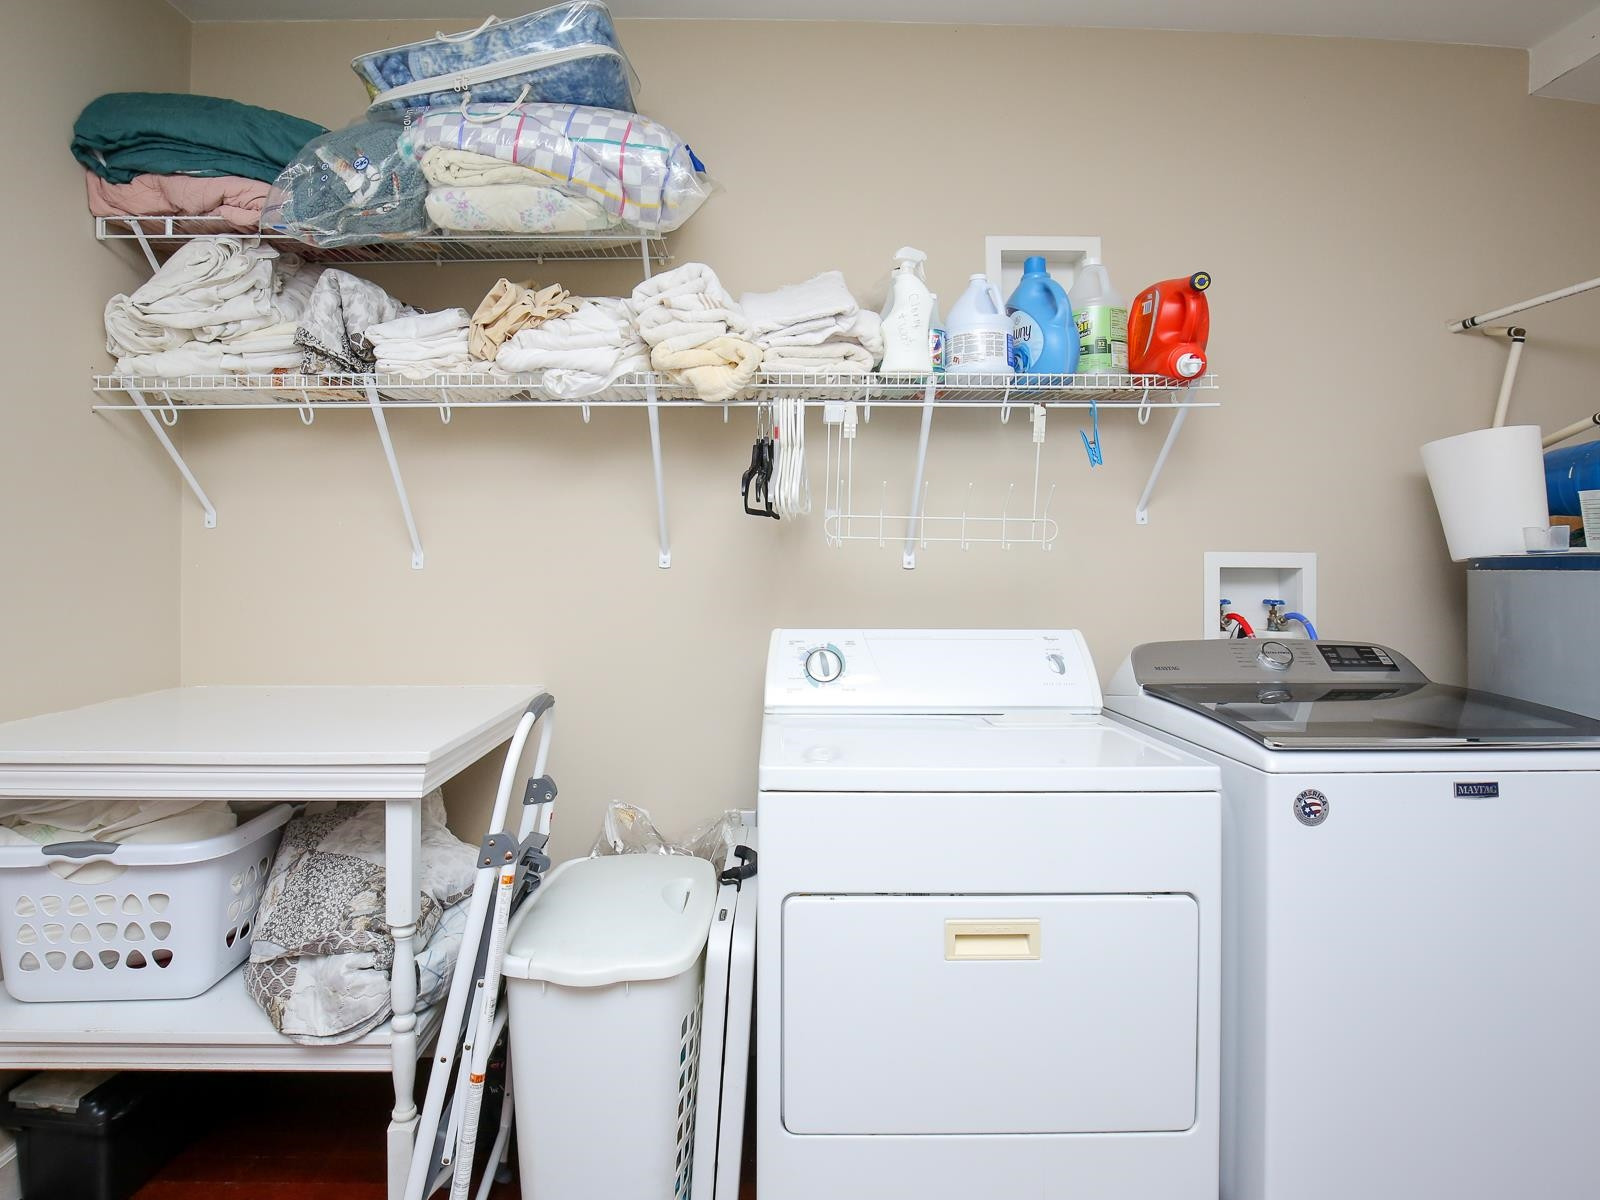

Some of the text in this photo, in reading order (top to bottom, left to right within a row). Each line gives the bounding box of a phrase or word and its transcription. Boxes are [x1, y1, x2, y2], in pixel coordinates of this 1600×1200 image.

[1013, 325, 1032, 342] wny
[1296, 790, 1328, 807] AMERICA
[1457, 785, 1497, 795] MAYTAG
